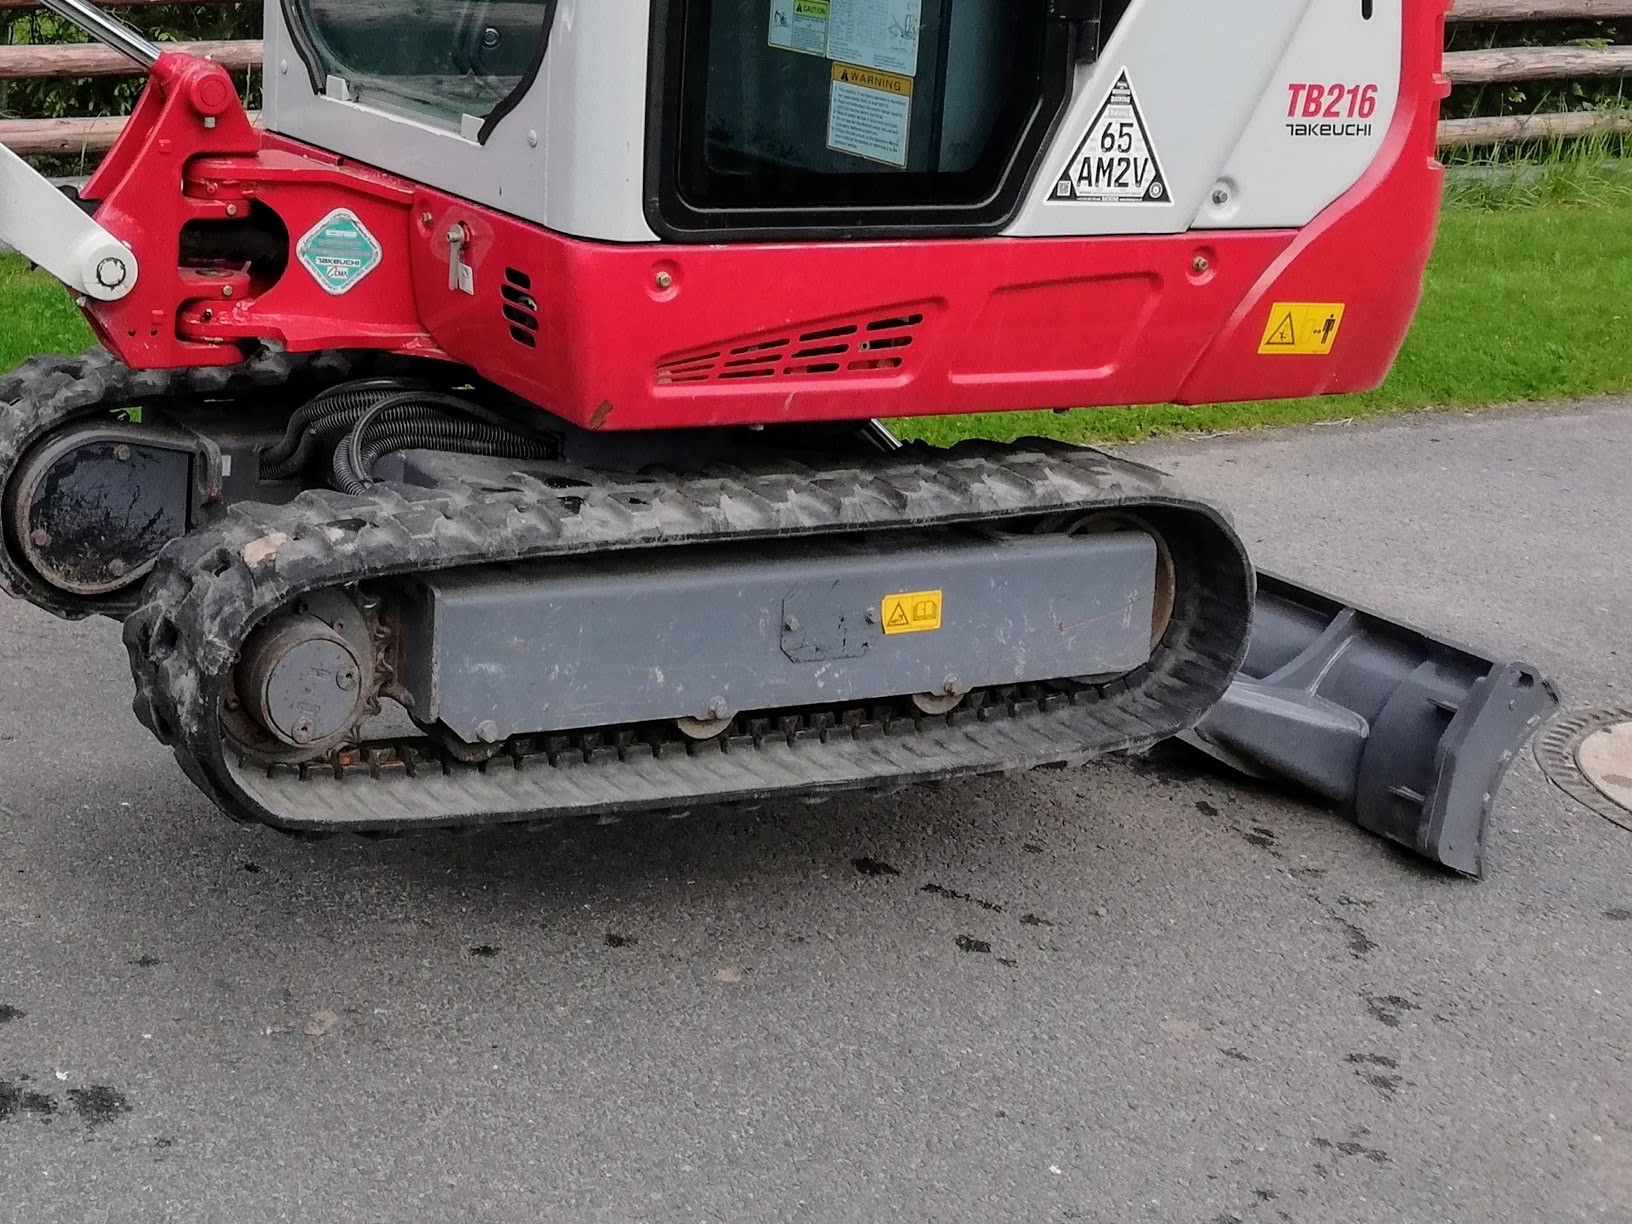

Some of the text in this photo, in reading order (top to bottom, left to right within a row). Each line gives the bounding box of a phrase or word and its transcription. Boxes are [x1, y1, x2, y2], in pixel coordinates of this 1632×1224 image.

[803, 5, 826, 15] CAUTION
[850, 72, 901, 91] WARNING
[1287, 83, 1378, 119] TB216
[1100, 122, 1134, 153] 65
[1285, 123, 1372, 137] TAKEUCHI
[1077, 156, 1149, 188] AM2V
